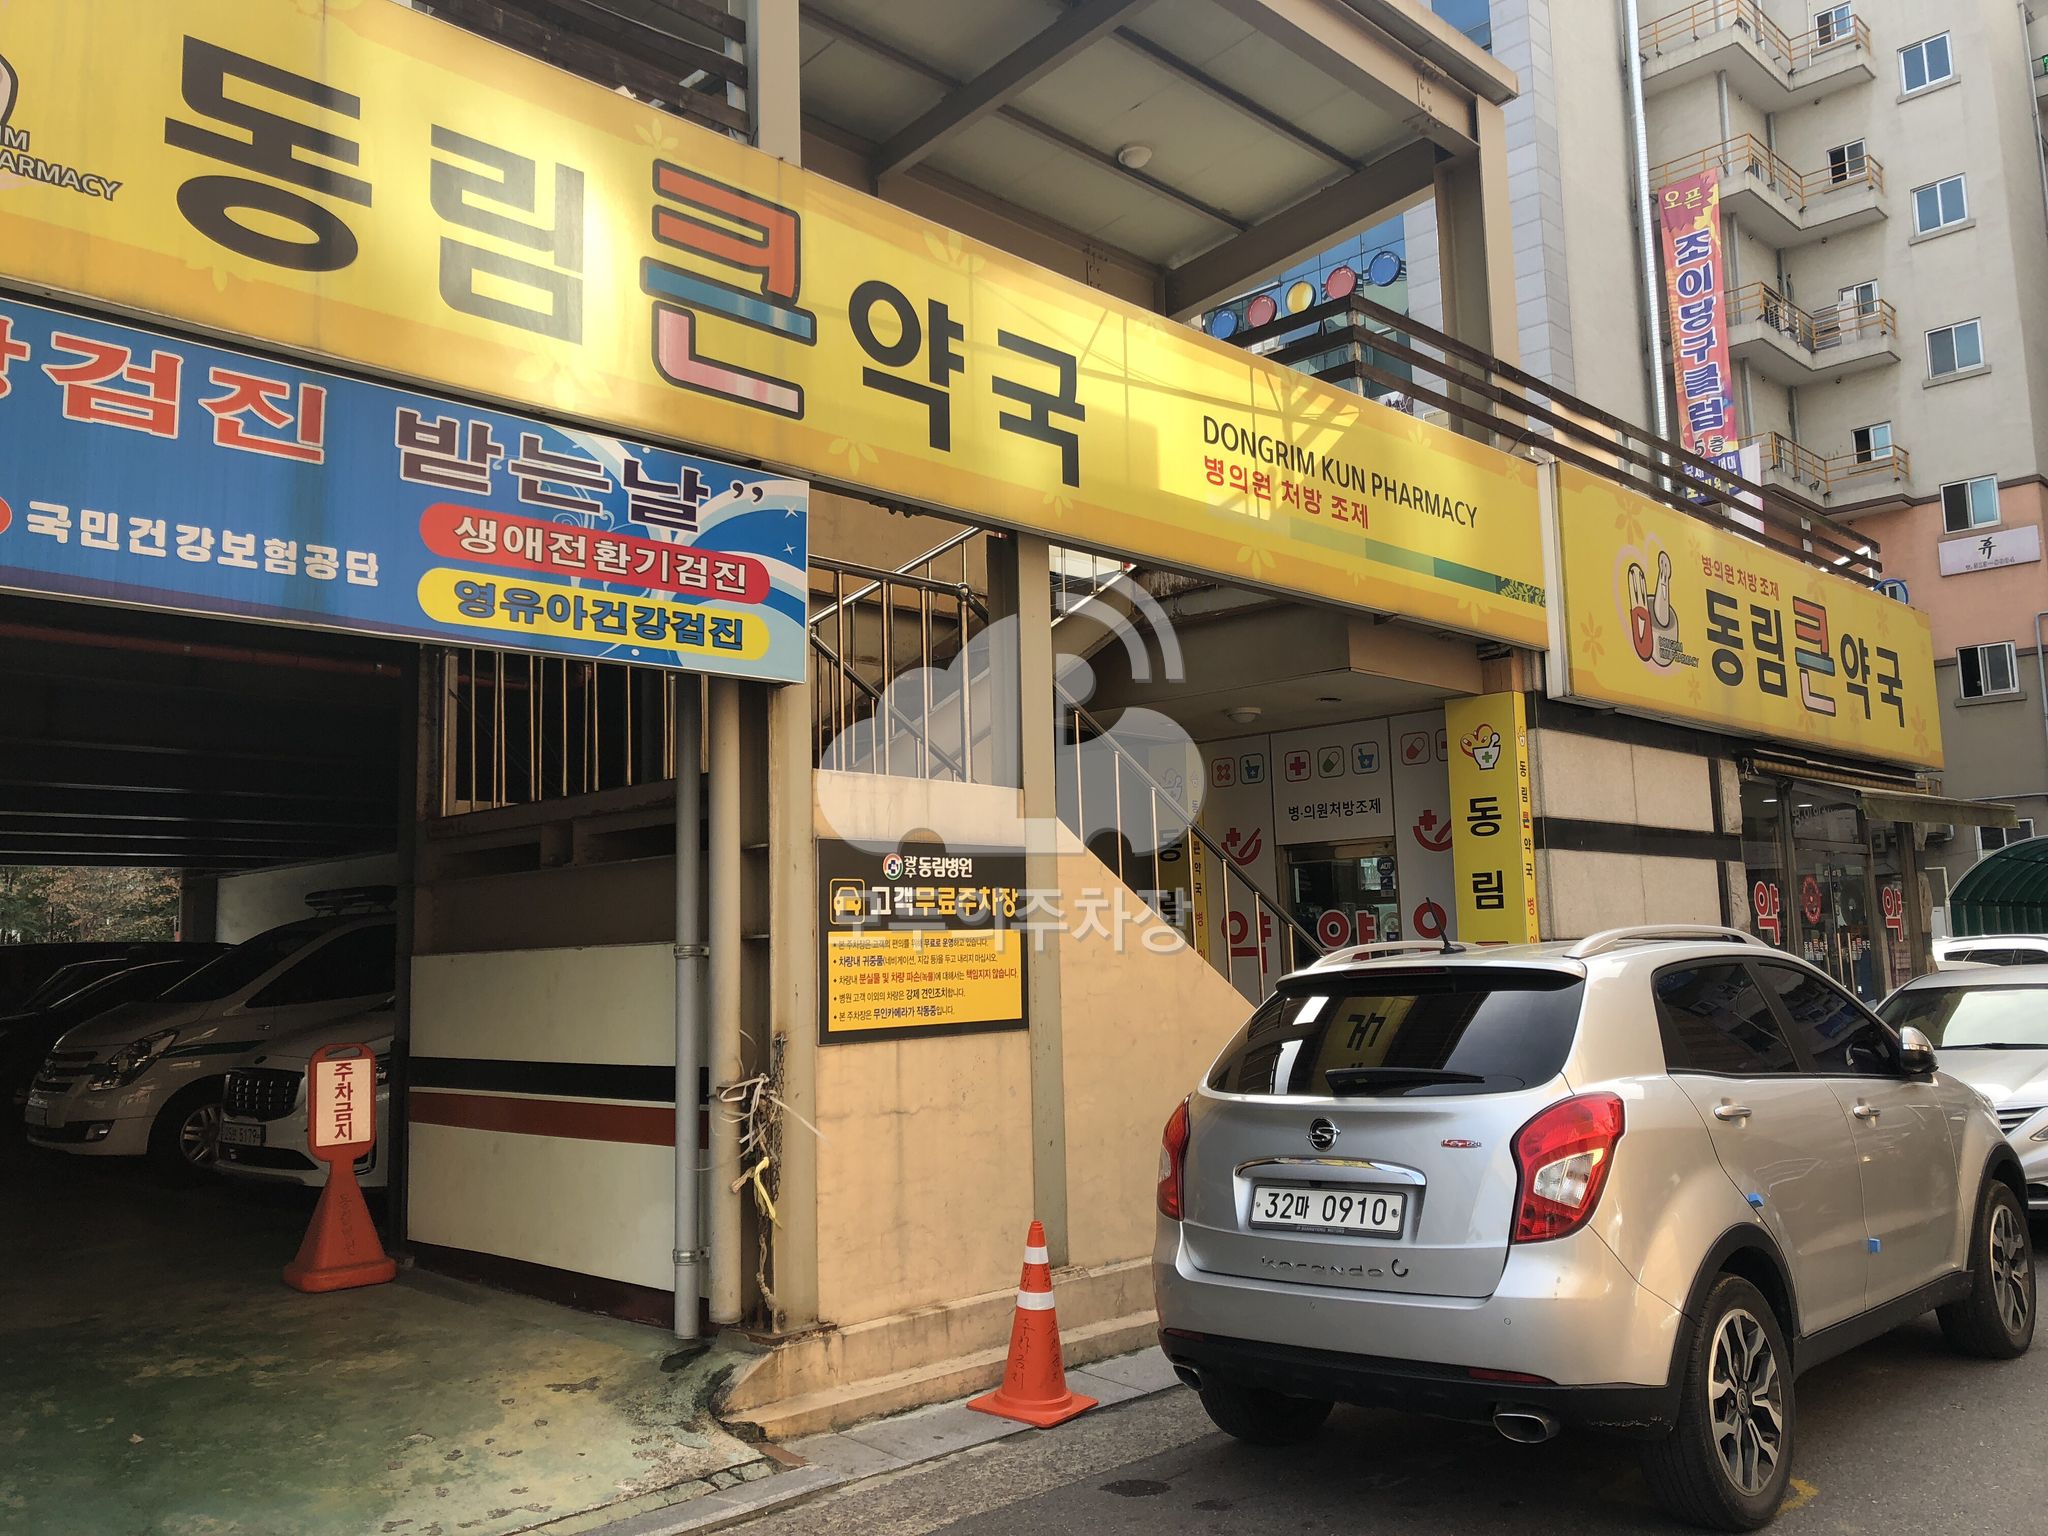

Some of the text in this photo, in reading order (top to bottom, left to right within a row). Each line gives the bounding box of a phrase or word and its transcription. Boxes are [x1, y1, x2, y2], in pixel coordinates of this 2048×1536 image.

[1664, 187, 1703, 210] 오픈
[1674, 228, 1726, 434] 조이당구클럽
[1203, 415, 1478, 529] DONGRIM KUN PHARMACY
[1203, 455, 1370, 530] 병의원 처방 조제
[27, 501, 380, 588] 국민건강보험공단
[452, 515, 749, 594] 생애전환기검진
[455, 580, 744, 652] 영유아건강검진
[1737, 569, 1757, 593] 처방
[1760, 577, 1780, 601] 조제
[1705, 588, 1905, 728] 동림큰약국
[918, 857, 973, 879] 동림병원
[1754, 881, 1780, 945] 약
[1882, 886, 1903, 942] 약
[333, 1062, 354, 1141] 주차금지
[1264, 1192, 1388, 1226] 32마 0910
